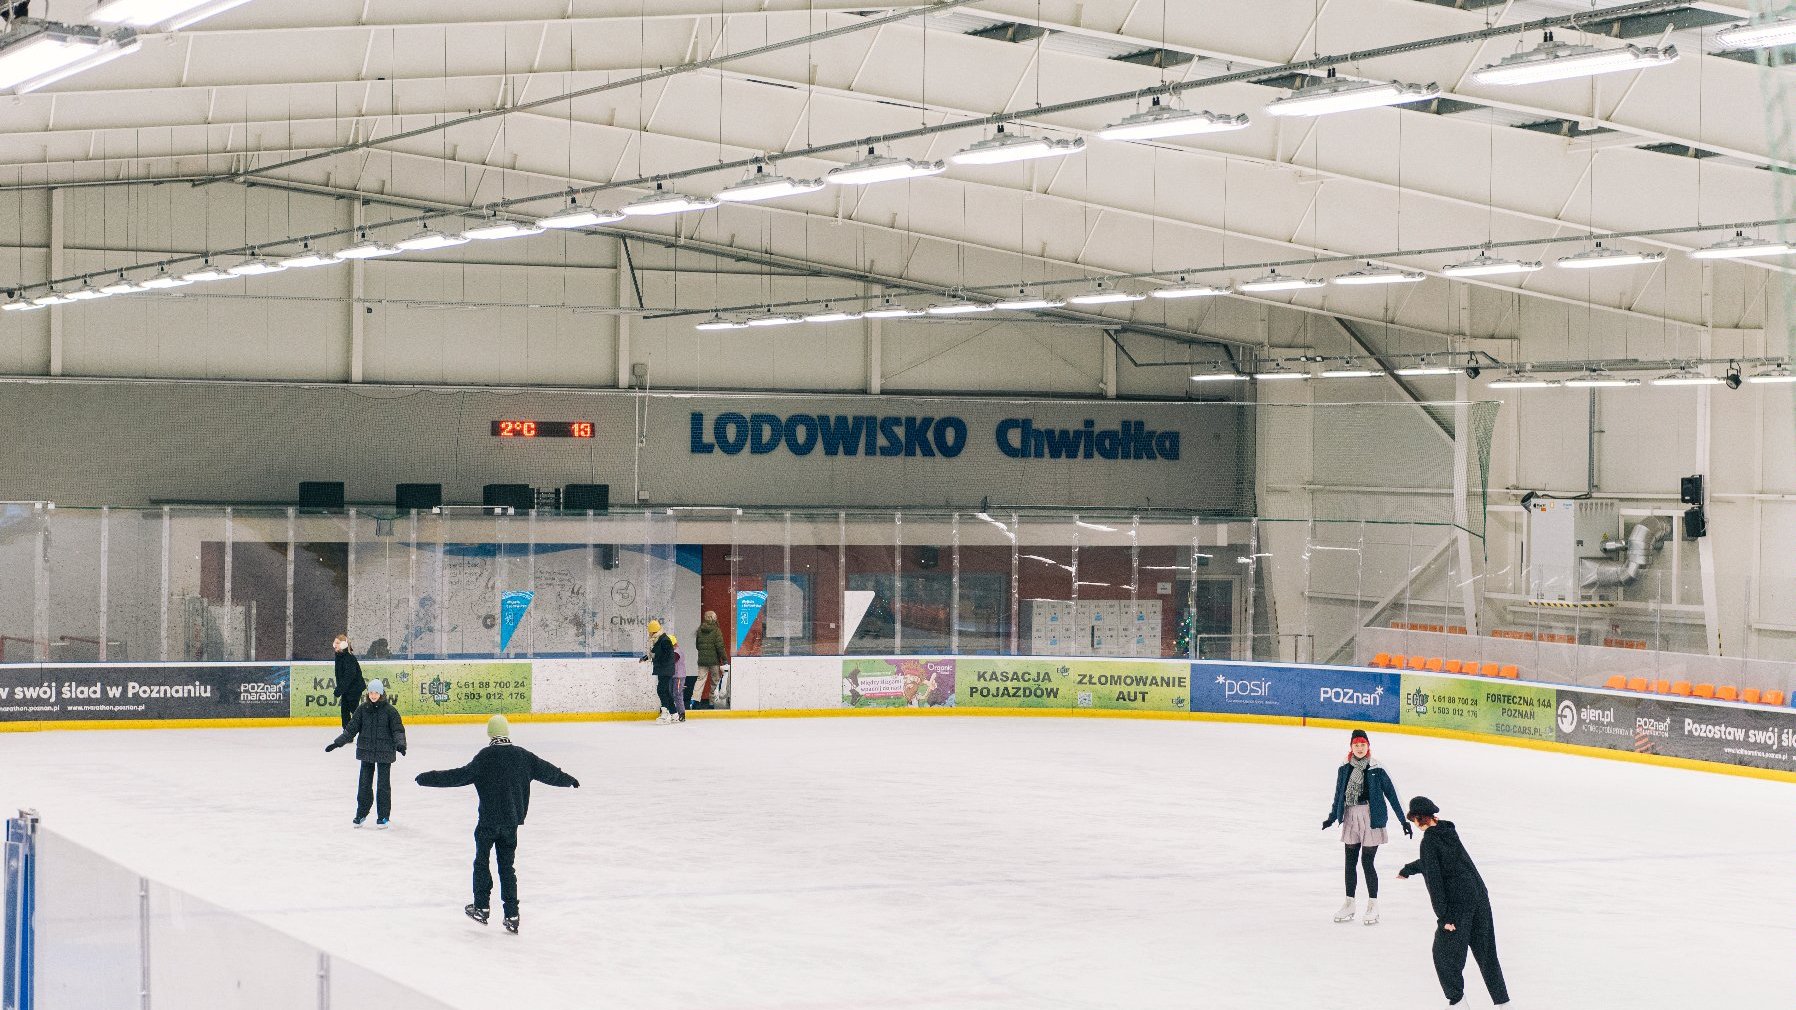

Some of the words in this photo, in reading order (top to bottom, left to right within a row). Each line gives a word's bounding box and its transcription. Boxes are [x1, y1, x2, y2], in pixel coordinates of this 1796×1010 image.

[500, 420, 536, 437] 2°C
[571, 422, 591, 438] 13
[690, 411, 967, 458] LODOWISKO
[995, 417, 1180, 461] Chwiałka
[927, 662, 953, 673] Organic
[977, 670, 1052, 683] KASACJA
[1077, 673, 1187, 688] ZŁOMOWANIE
[14, 681, 56, 702] swój
[61, 682, 101, 699] ślad
[106, 686, 122, 698] w
[127, 681, 211, 698] Poznaniu
[463, 681, 475, 689] 61
[493, 681, 511, 689] 700
[513, 680, 526, 689] 24
[969, 683, 1060, 699] POJAZDÓW
[1225, 678, 1272, 699] posir
[240, 691, 283, 700] maraton
[464, 692, 481, 701] 503
[485, 692, 504, 701] 012
[508, 692, 526, 700] 176
[1115, 690, 1149, 703] AUT
[1486, 692, 1534, 707] FORTECZNA
[1536, 698, 1552, 709] 14A
[1437, 707, 1450, 715] 503
[1452, 708, 1464, 717] 012
[1580, 705, 1615, 724] ajen.pl
[1684, 717, 1746, 742] Pozostaw
[1748, 726, 1779, 750] swój
